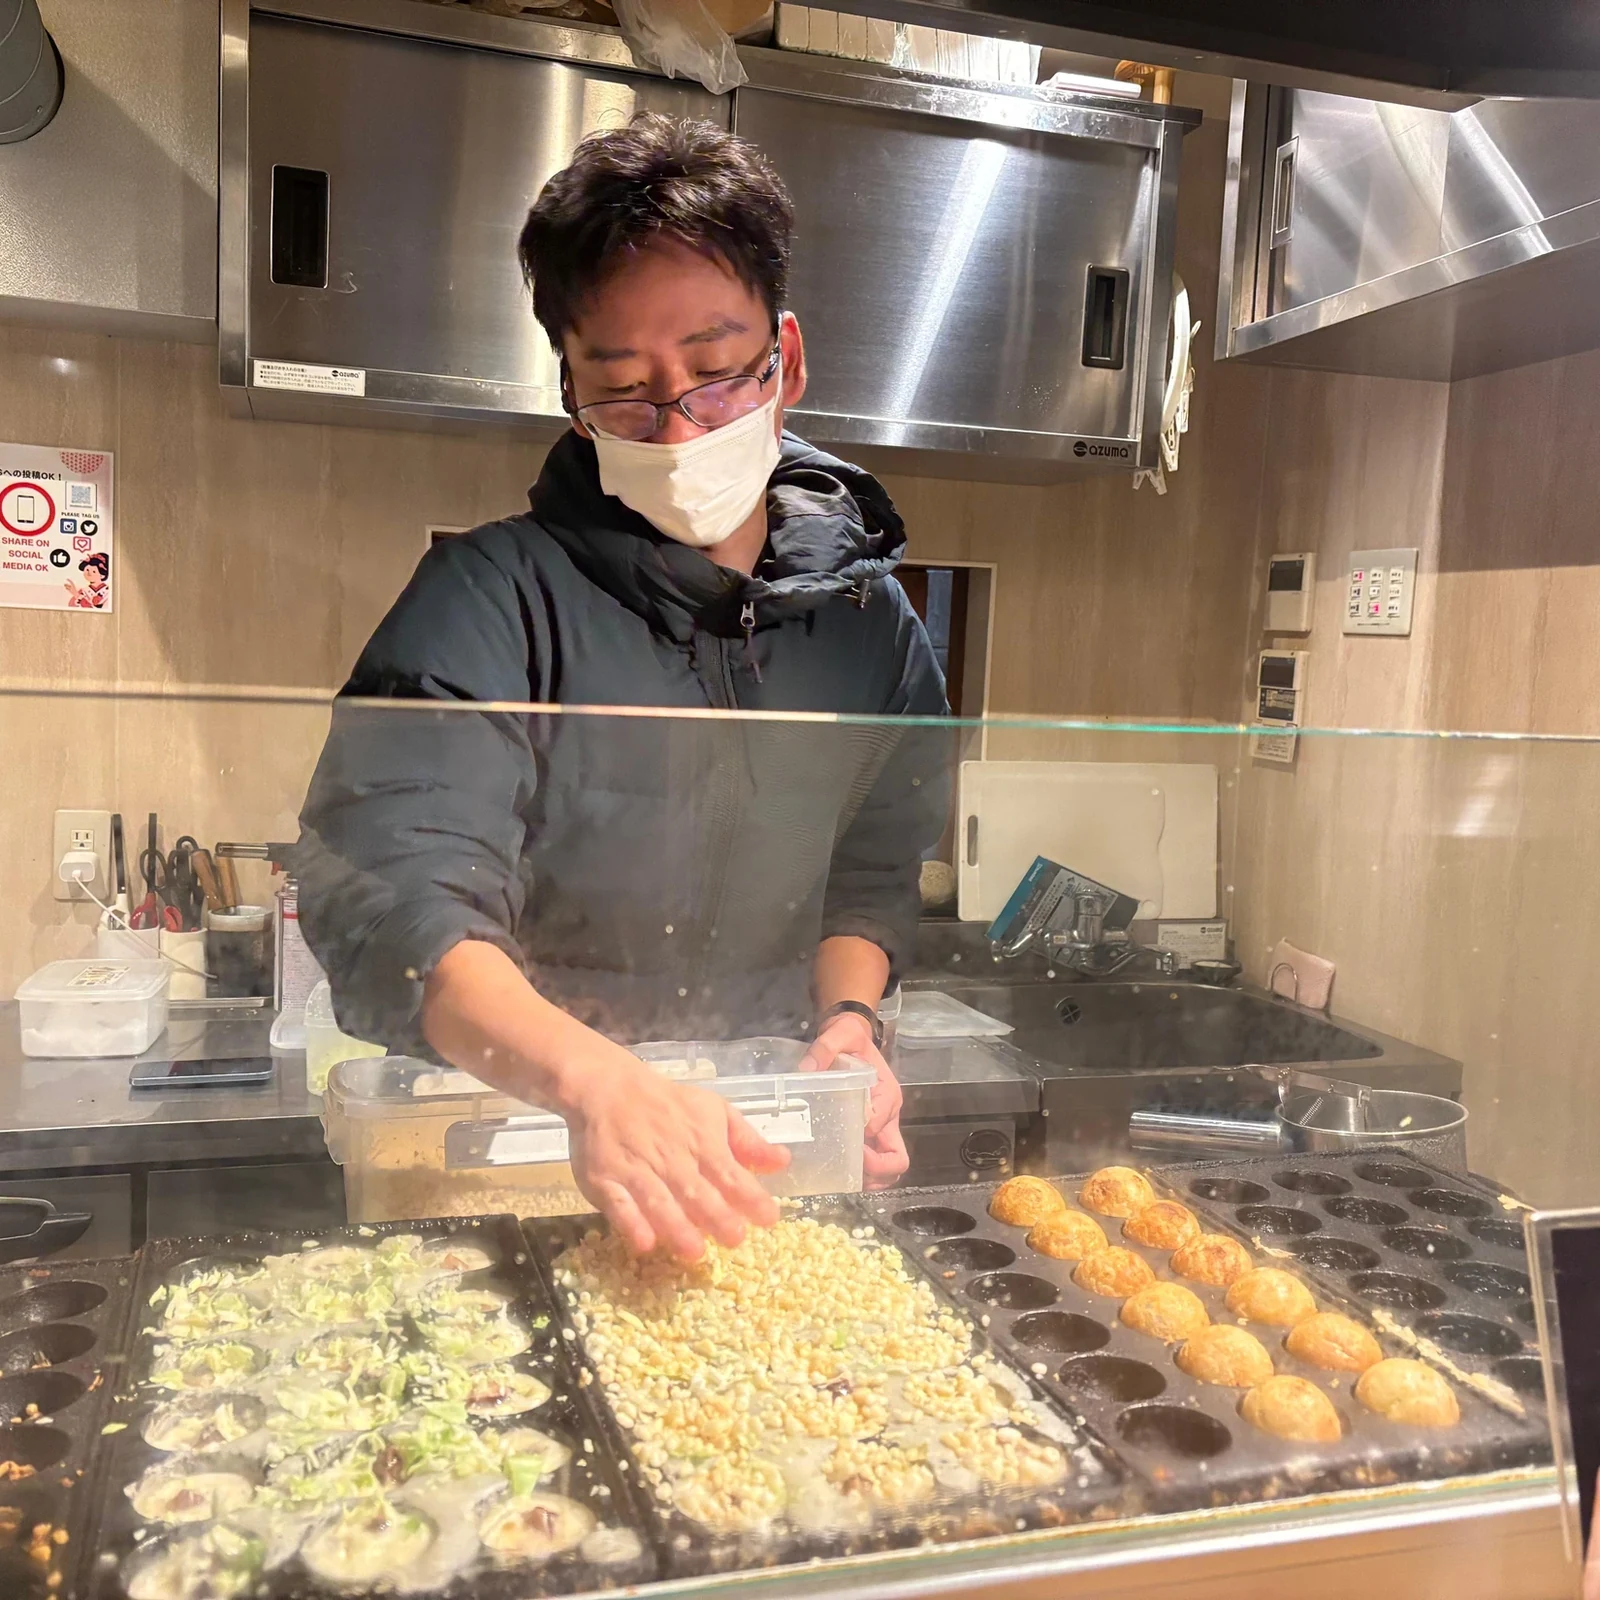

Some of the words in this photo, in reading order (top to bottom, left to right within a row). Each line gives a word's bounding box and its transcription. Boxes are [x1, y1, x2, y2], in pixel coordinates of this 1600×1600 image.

[1088, 445, 1129, 458] azuma
[1, 536, 34, 547] SHARE
[36, 539, 50, 548] ON
[8, 549, 44, 560] SOCIAL
[2, 561, 33, 571] MEDIA
[35, 563, 49, 572] OK
